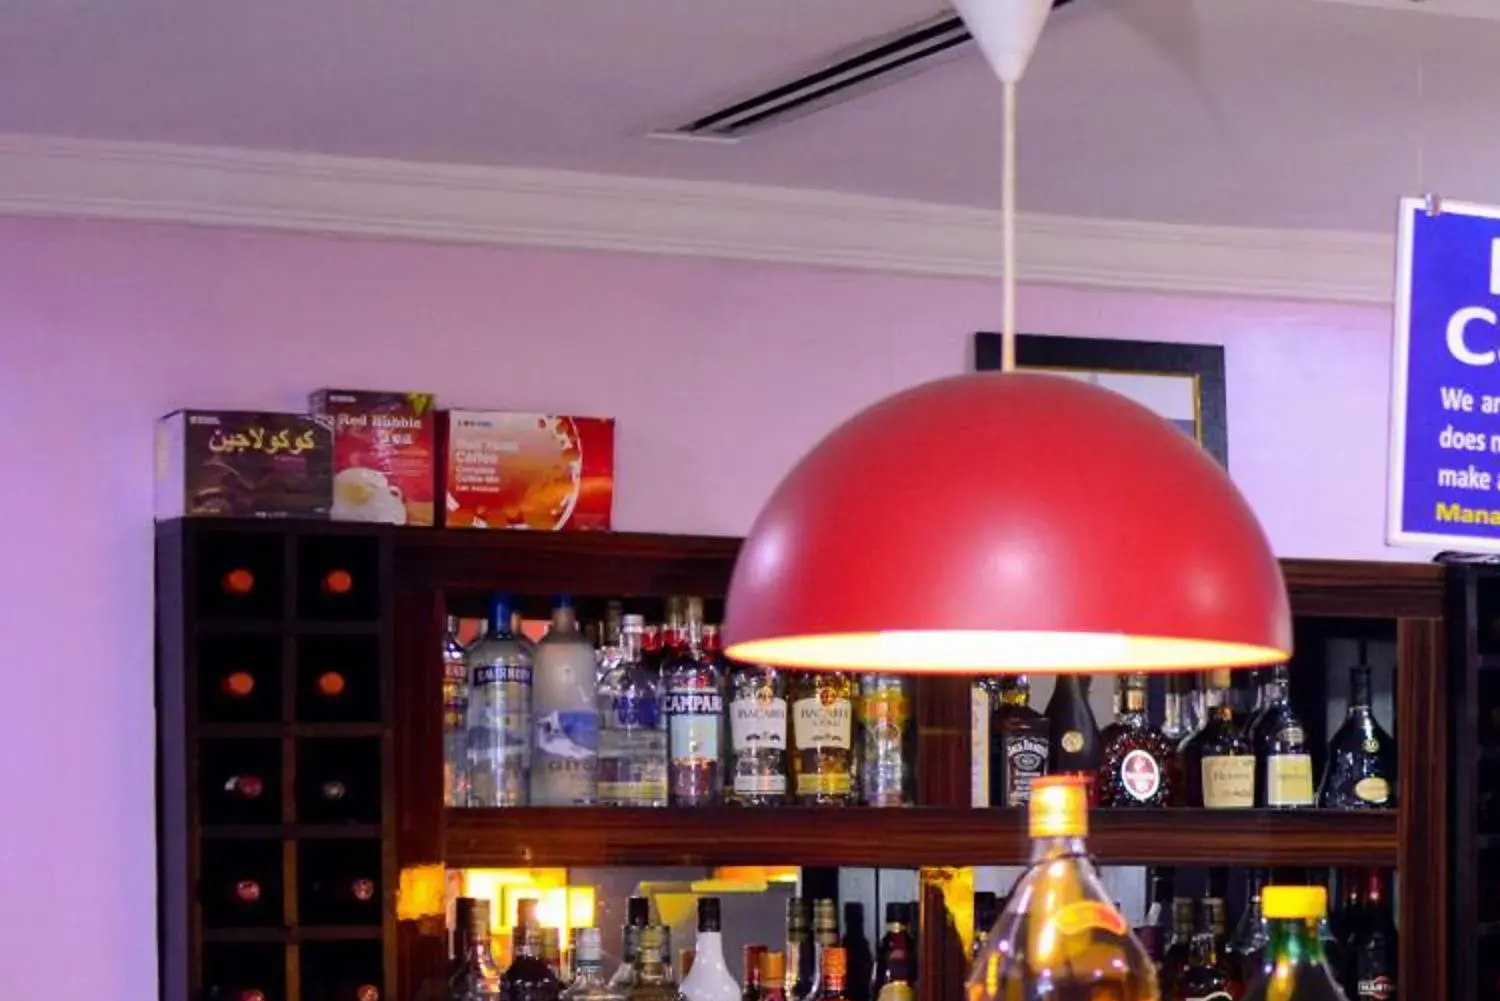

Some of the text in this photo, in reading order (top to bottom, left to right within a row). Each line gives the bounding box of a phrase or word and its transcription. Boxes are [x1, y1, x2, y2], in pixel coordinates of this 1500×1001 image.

[1440, 386, 1474, 411] We
[1439, 424, 1486, 451] does
[1437, 465, 1491, 490] make
